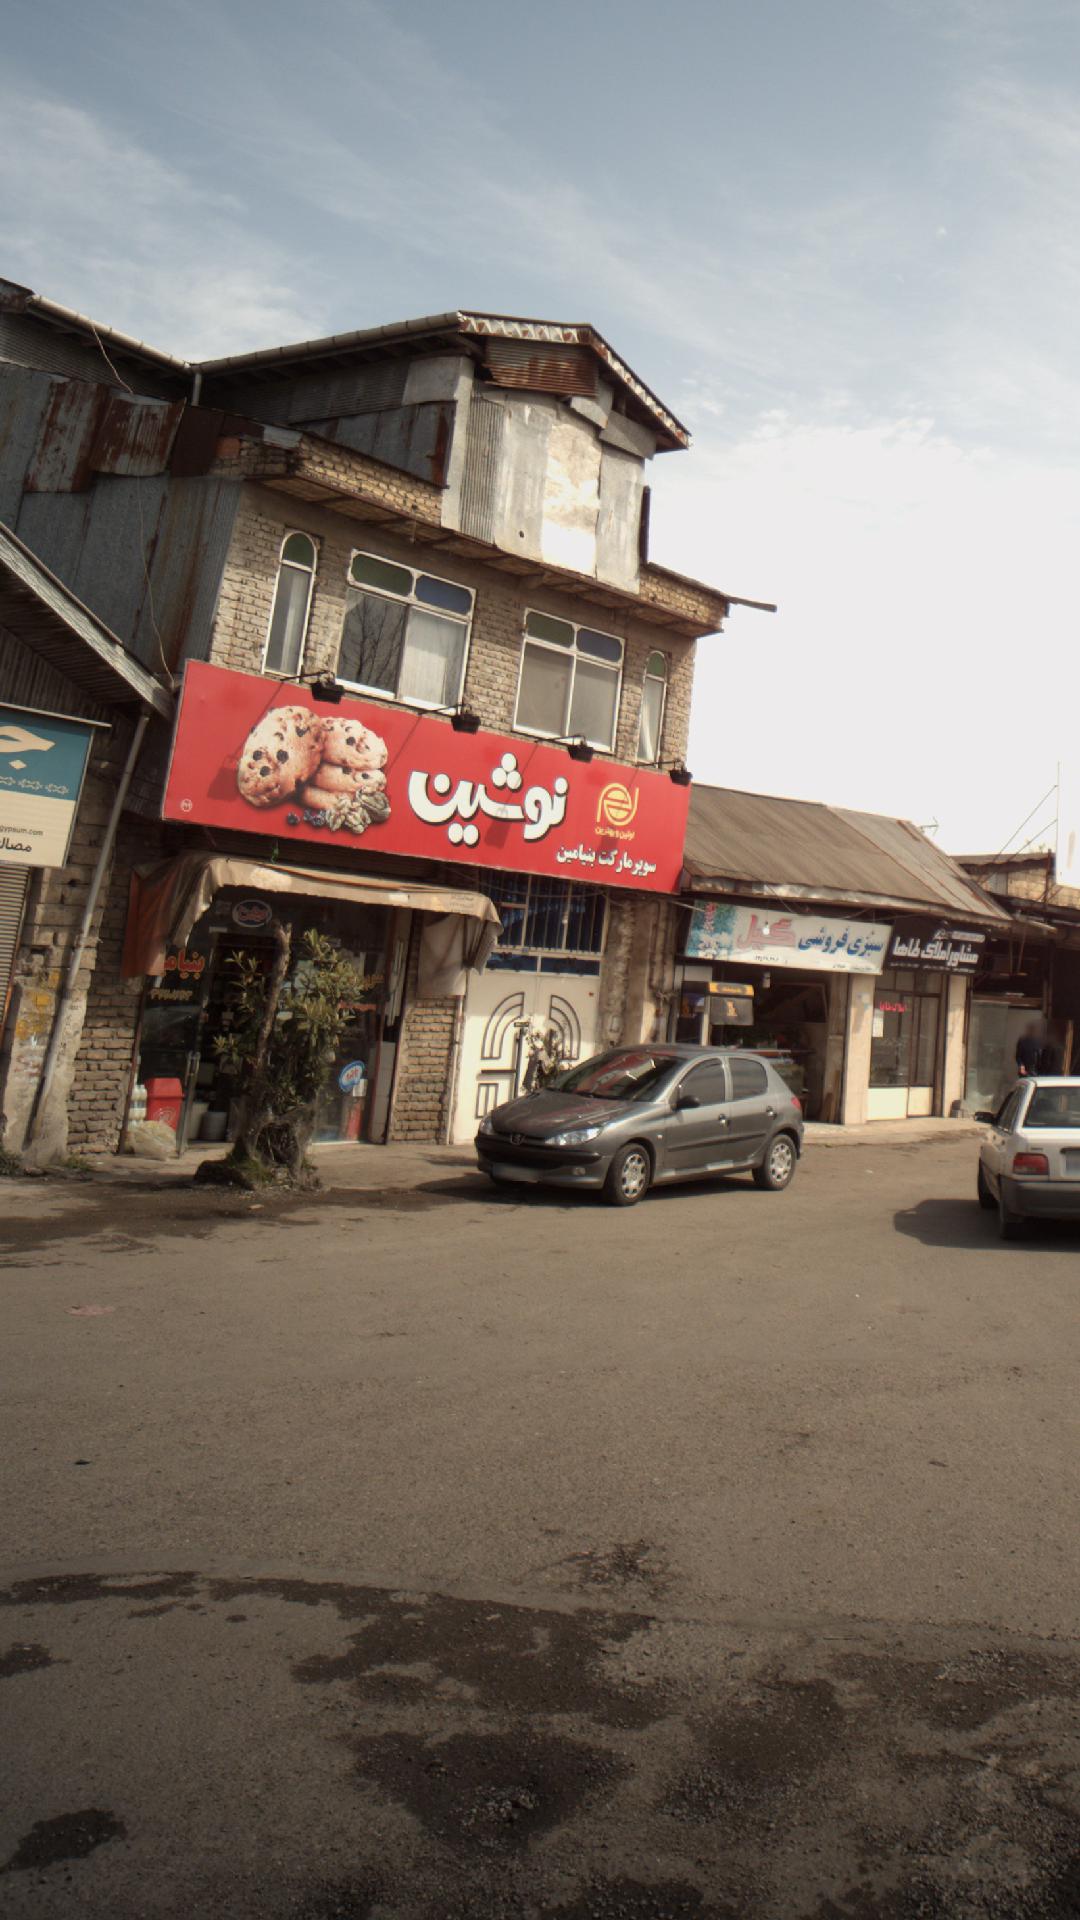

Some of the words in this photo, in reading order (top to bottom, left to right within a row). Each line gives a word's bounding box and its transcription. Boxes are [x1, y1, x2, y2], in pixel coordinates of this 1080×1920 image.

[408, 752, 569, 846] نوشین
[0, 837, 32, 852] مصال
[556, 843, 596, 867] بنیامین
[798, 926, 849, 954] فروشی
[846, 930, 884, 956] سبزی
[892, 936, 921, 958] طاها
[920, 940, 953, 961] املاک
[946, 943, 979, 967] مشاور
